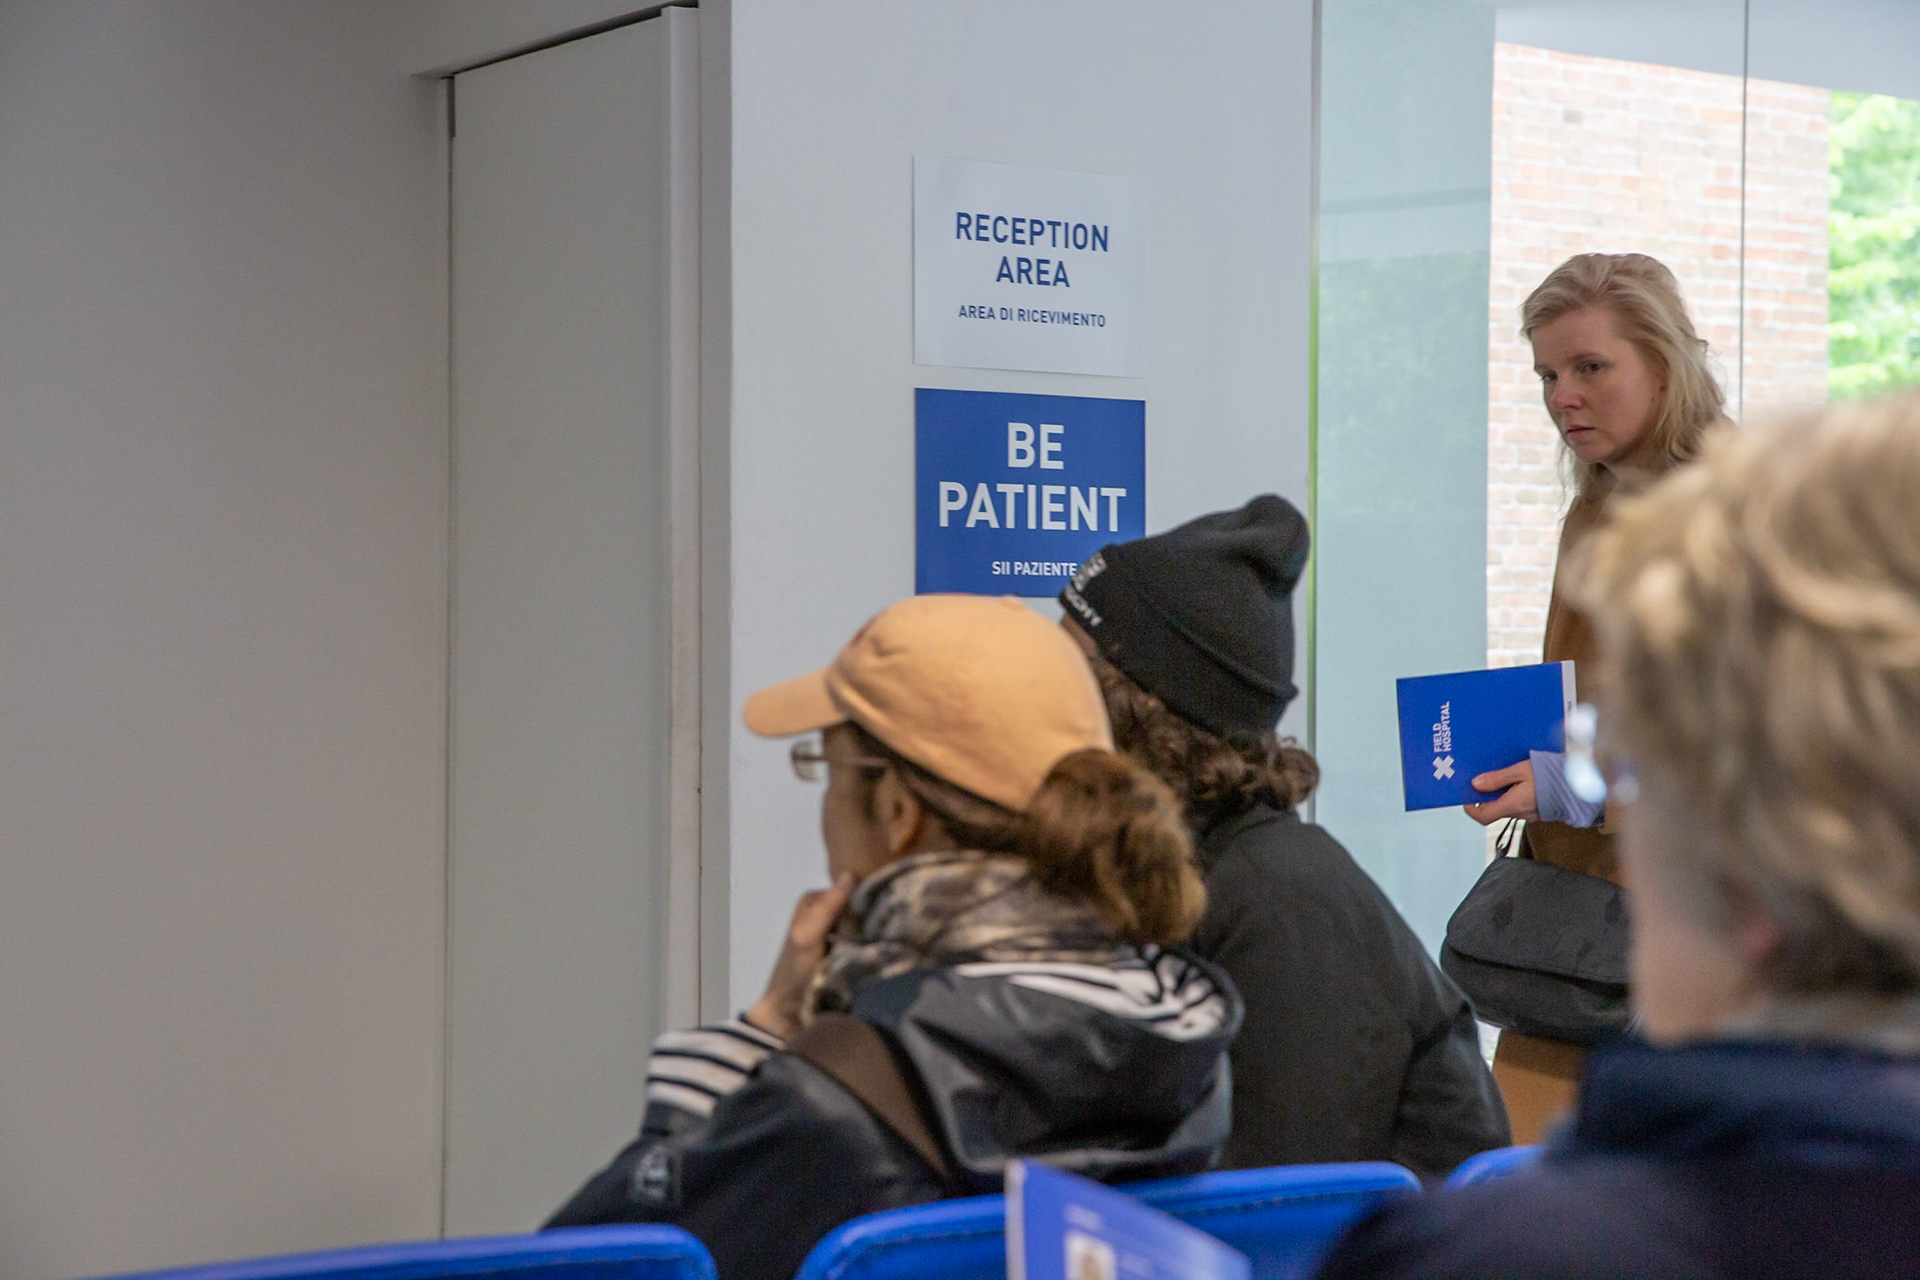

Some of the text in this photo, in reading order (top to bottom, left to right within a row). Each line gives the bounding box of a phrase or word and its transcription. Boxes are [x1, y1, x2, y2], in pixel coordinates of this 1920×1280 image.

[956, 212, 1109, 252] RECEPTION
[996, 256, 1070, 287] AREA
[958, 304, 1106, 328] AREA DI RICEVIMENTO
[1007, 422, 1064, 470] BE
[938, 481, 1127, 532] PATIENT
[991, 561, 1078, 577] SII PAZIENTE
[1432, 723, 1442, 753] FIELD
[1441, 701, 1452, 752] HOSPITAL
